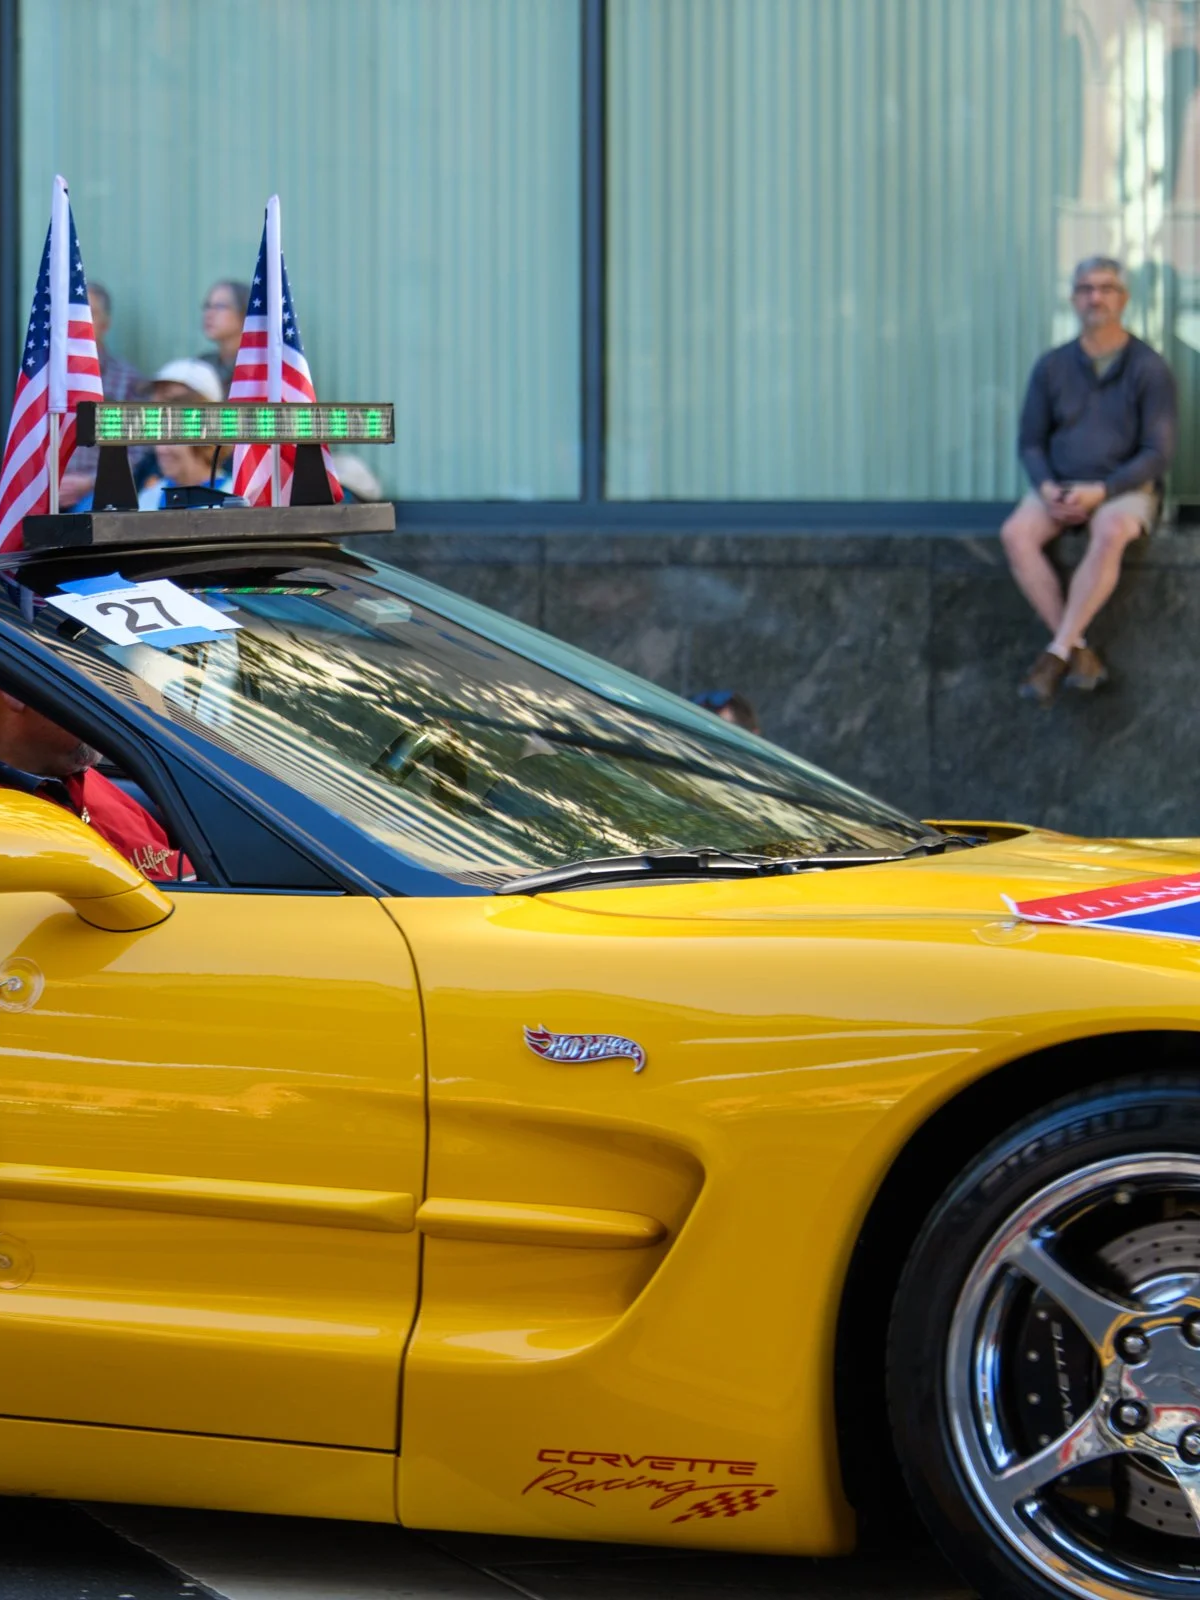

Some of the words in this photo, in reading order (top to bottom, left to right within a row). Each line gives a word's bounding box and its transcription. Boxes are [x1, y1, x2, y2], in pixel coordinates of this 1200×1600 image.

[96, 596, 183, 634] 27
[1051, 1320, 1075, 1430] RVETTE
[536, 1448, 758, 1476] CORVETTE
[521, 1467, 775, 1511] Racing
